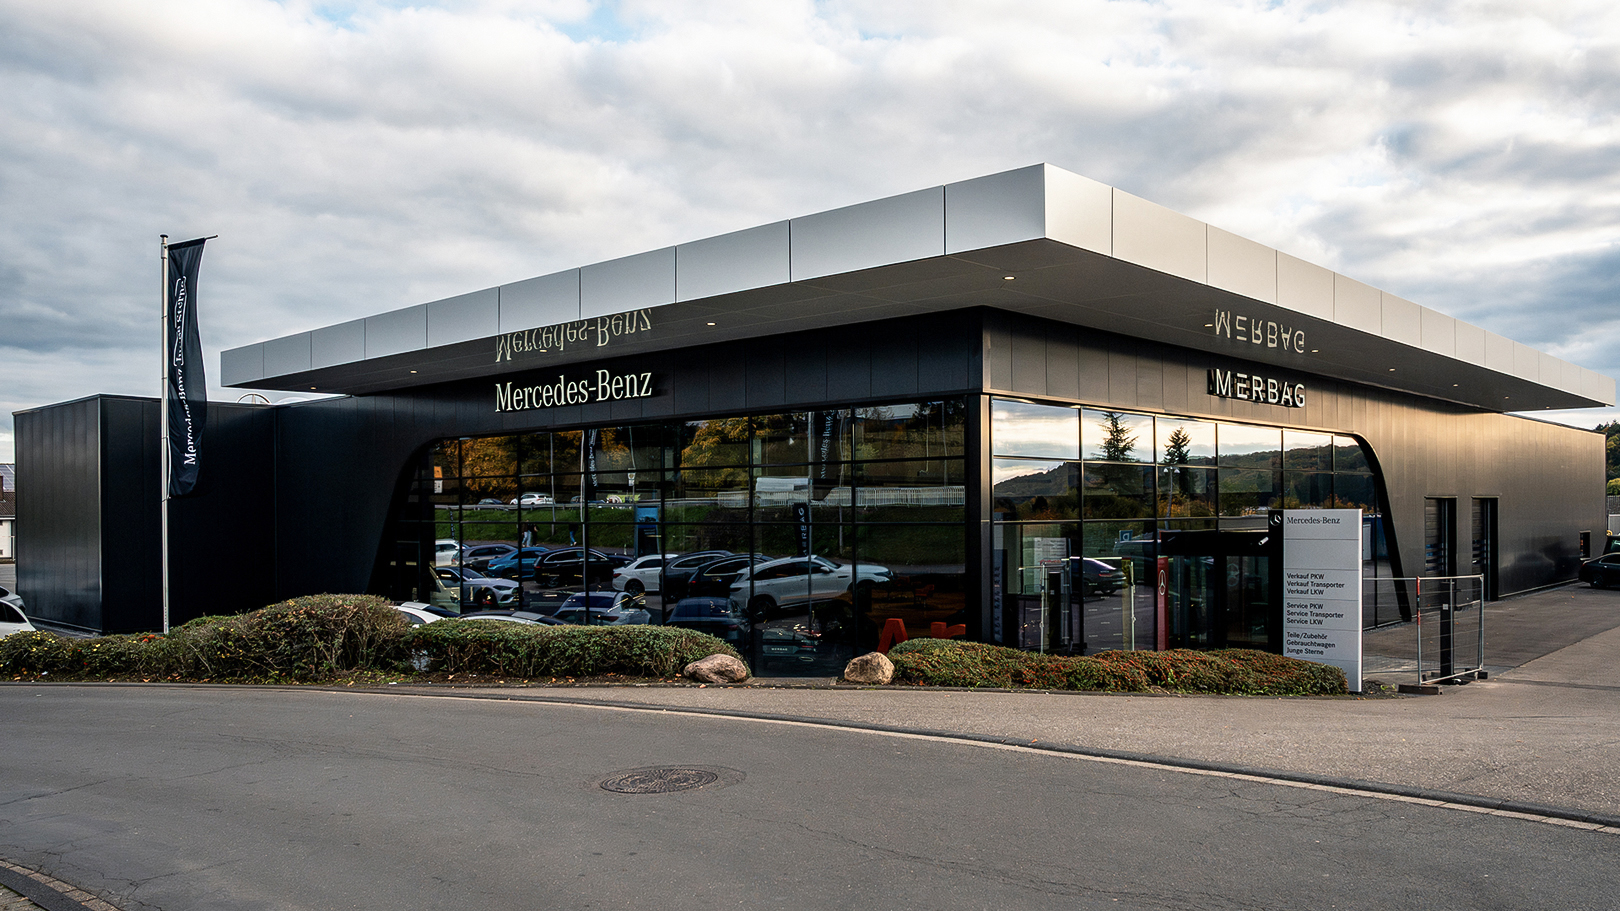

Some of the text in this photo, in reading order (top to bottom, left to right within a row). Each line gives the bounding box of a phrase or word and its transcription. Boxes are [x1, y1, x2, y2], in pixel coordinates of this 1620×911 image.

[495, 369, 652, 412] Mercedes-Benz
[1216, 368, 1305, 407] MERBAG
[1286, 516, 1341, 525] Mercedes-Benz
[1286, 572, 1309, 580] Verkauf
[1310, 581, 1345, 589] Transporter
[1309, 610, 1344, 619] Transporter
[1286, 617, 1308, 625] Service
[1286, 631, 1328, 640] Teile/Zubehör
[1286, 639, 1336, 649] Gebrauchtwagen
[1286, 647, 1324, 656] Junge Sterne
